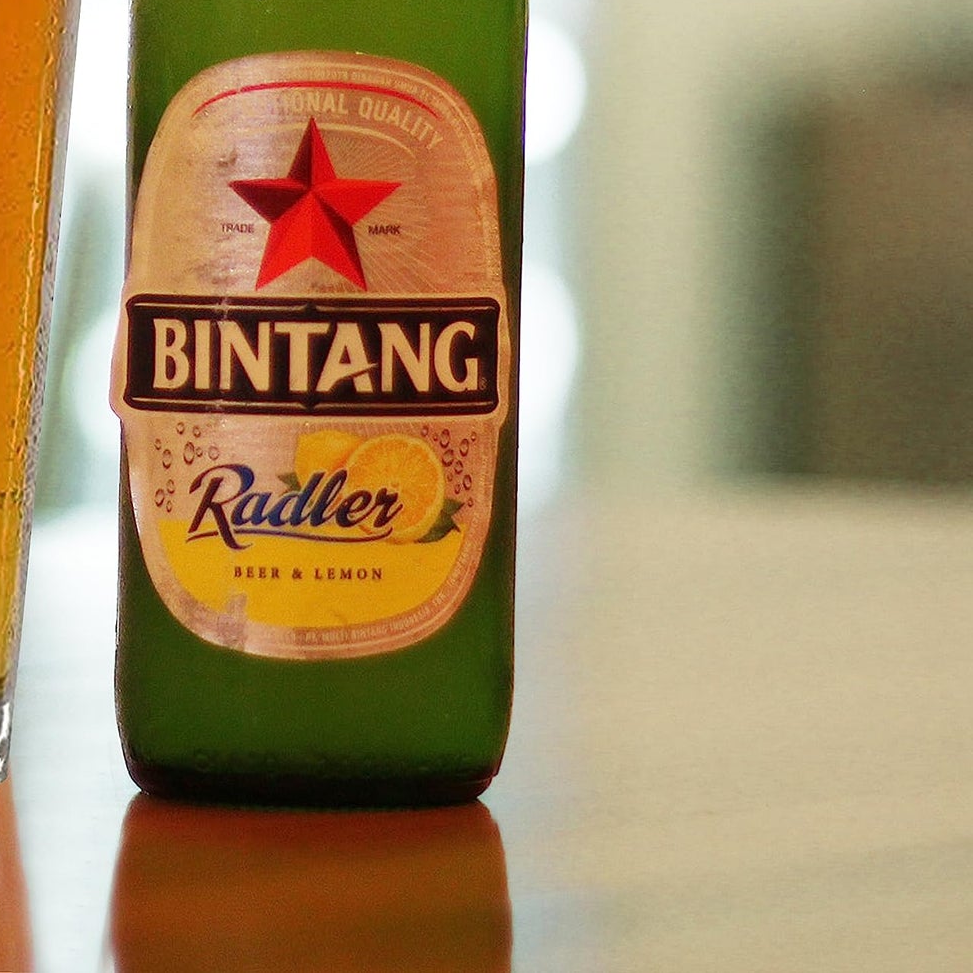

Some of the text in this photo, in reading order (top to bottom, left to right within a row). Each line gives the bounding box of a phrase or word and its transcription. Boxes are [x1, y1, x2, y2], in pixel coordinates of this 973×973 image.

[357, 96, 444, 150] QUALITY
[221, 223, 255, 234] TRADE
[368, 224, 401, 235] MARK
[152, 317, 480, 393] BINTANG
[185, 463, 404, 551] Radler
[234, 566, 383, 580] BEER & LEMON
